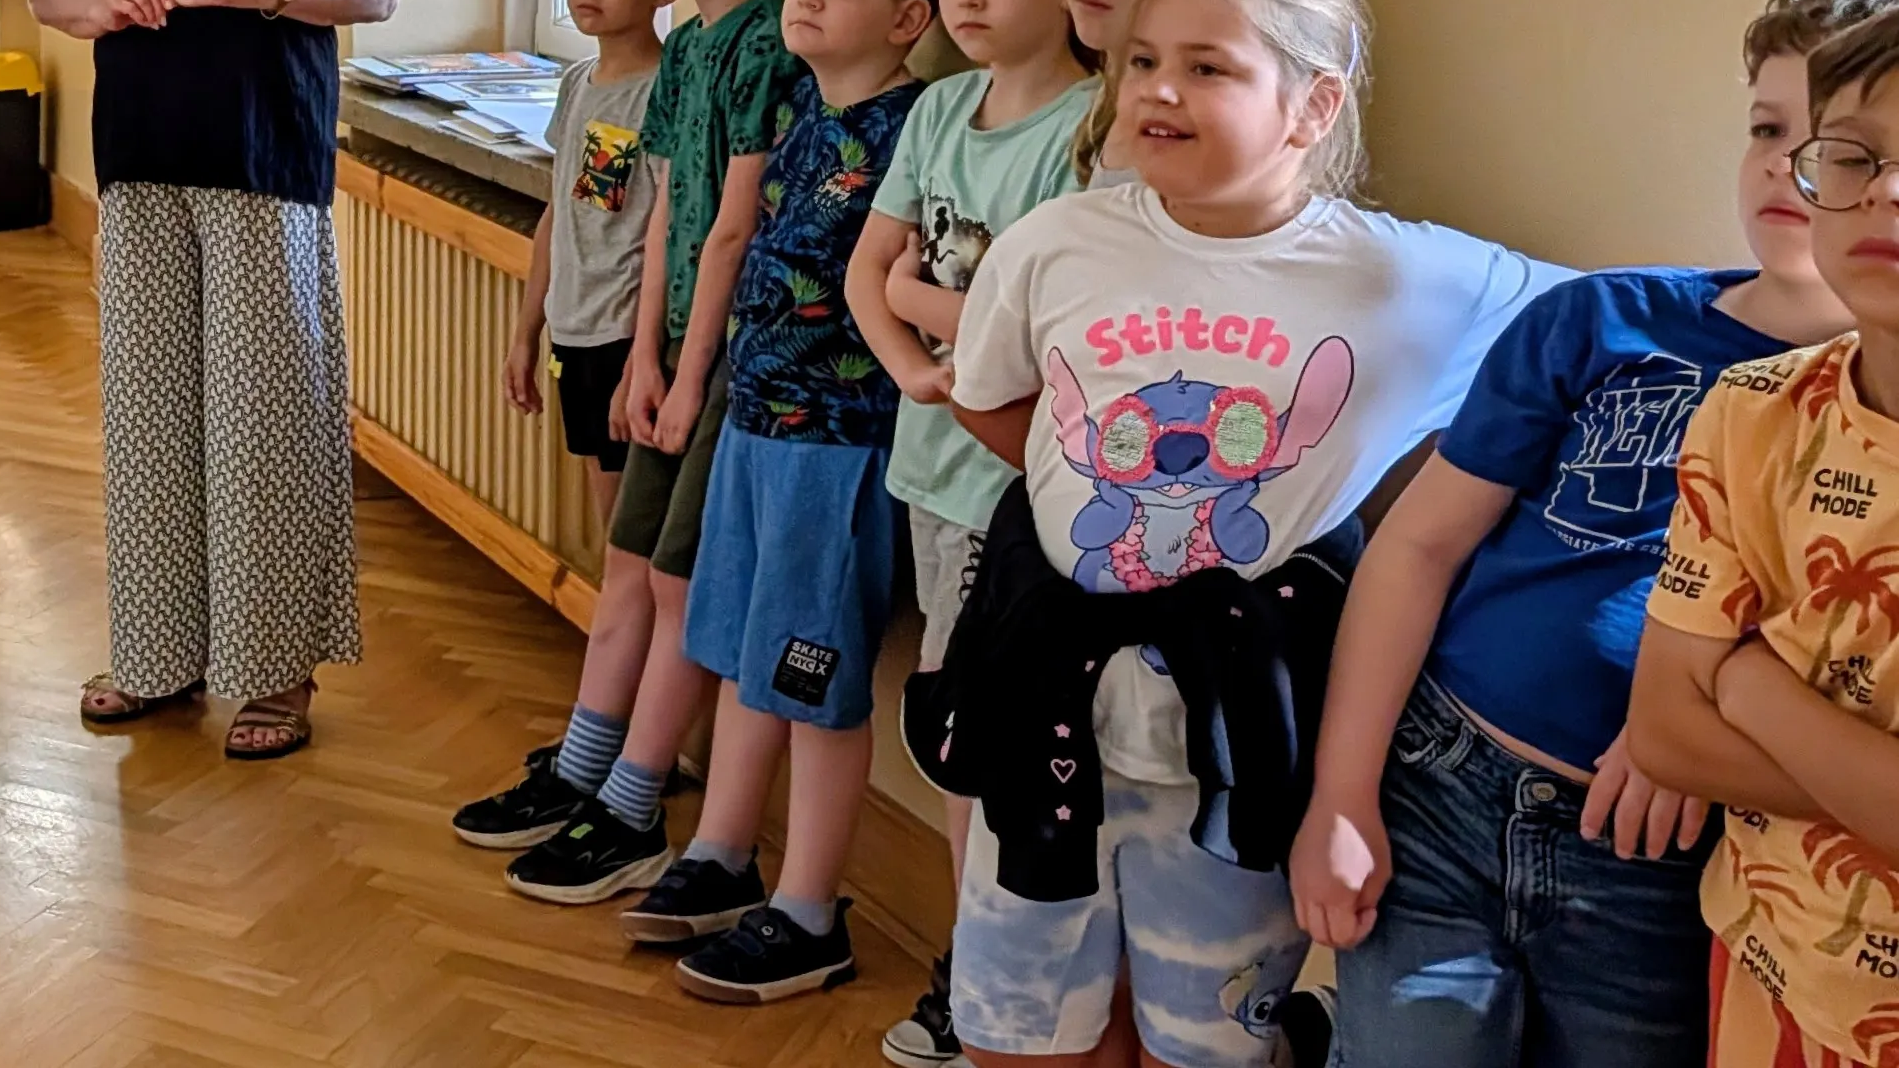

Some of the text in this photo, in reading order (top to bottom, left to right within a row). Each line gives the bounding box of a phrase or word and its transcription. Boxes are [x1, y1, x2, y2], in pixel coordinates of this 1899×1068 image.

[1085, 306, 1291, 368] Stitch
[1813, 468, 1878, 497] CHILL
[1809, 493, 1872, 519] MODE
[789, 654, 828, 676] NYC X
[792, 641, 833, 663] SKATE
[1746, 935, 1787, 986] CHILL
[1739, 951, 1784, 1004] MODE
